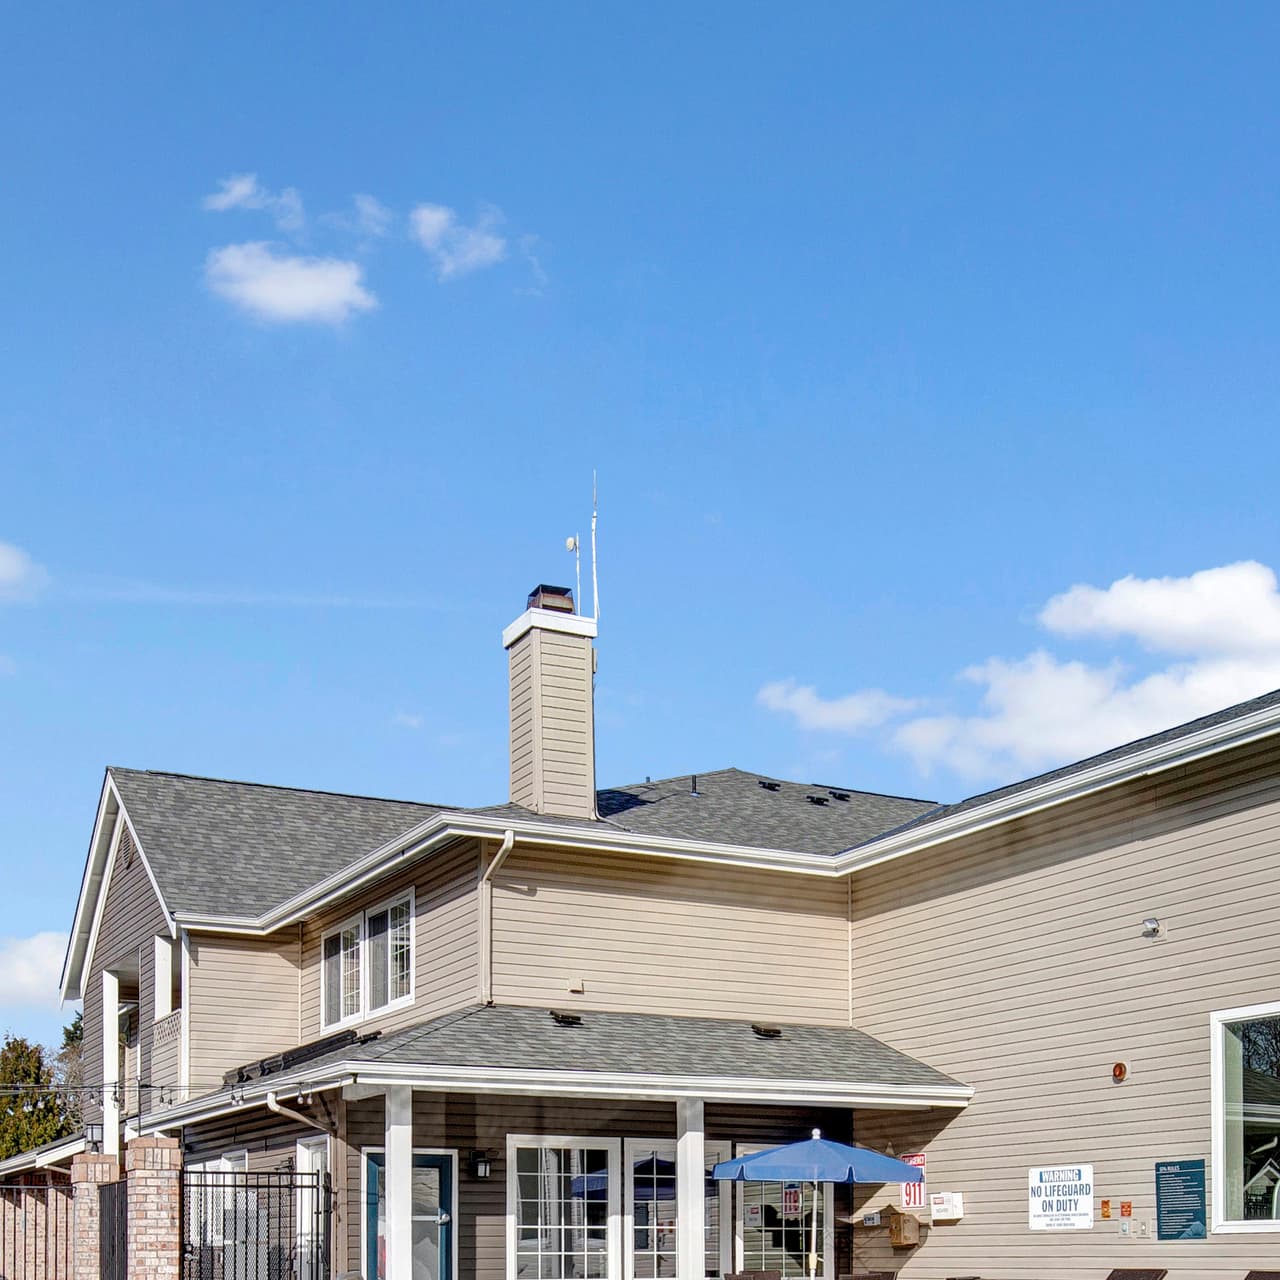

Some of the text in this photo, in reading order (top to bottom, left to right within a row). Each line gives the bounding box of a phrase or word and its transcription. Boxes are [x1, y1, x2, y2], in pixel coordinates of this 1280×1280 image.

[1042, 1169, 1080, 1183] WARNING
[905, 1183, 922, 1205] 911
[1031, 1183, 1091, 1198] NO LIFEGUARD
[1042, 1199, 1079, 1212] ON DUTY
